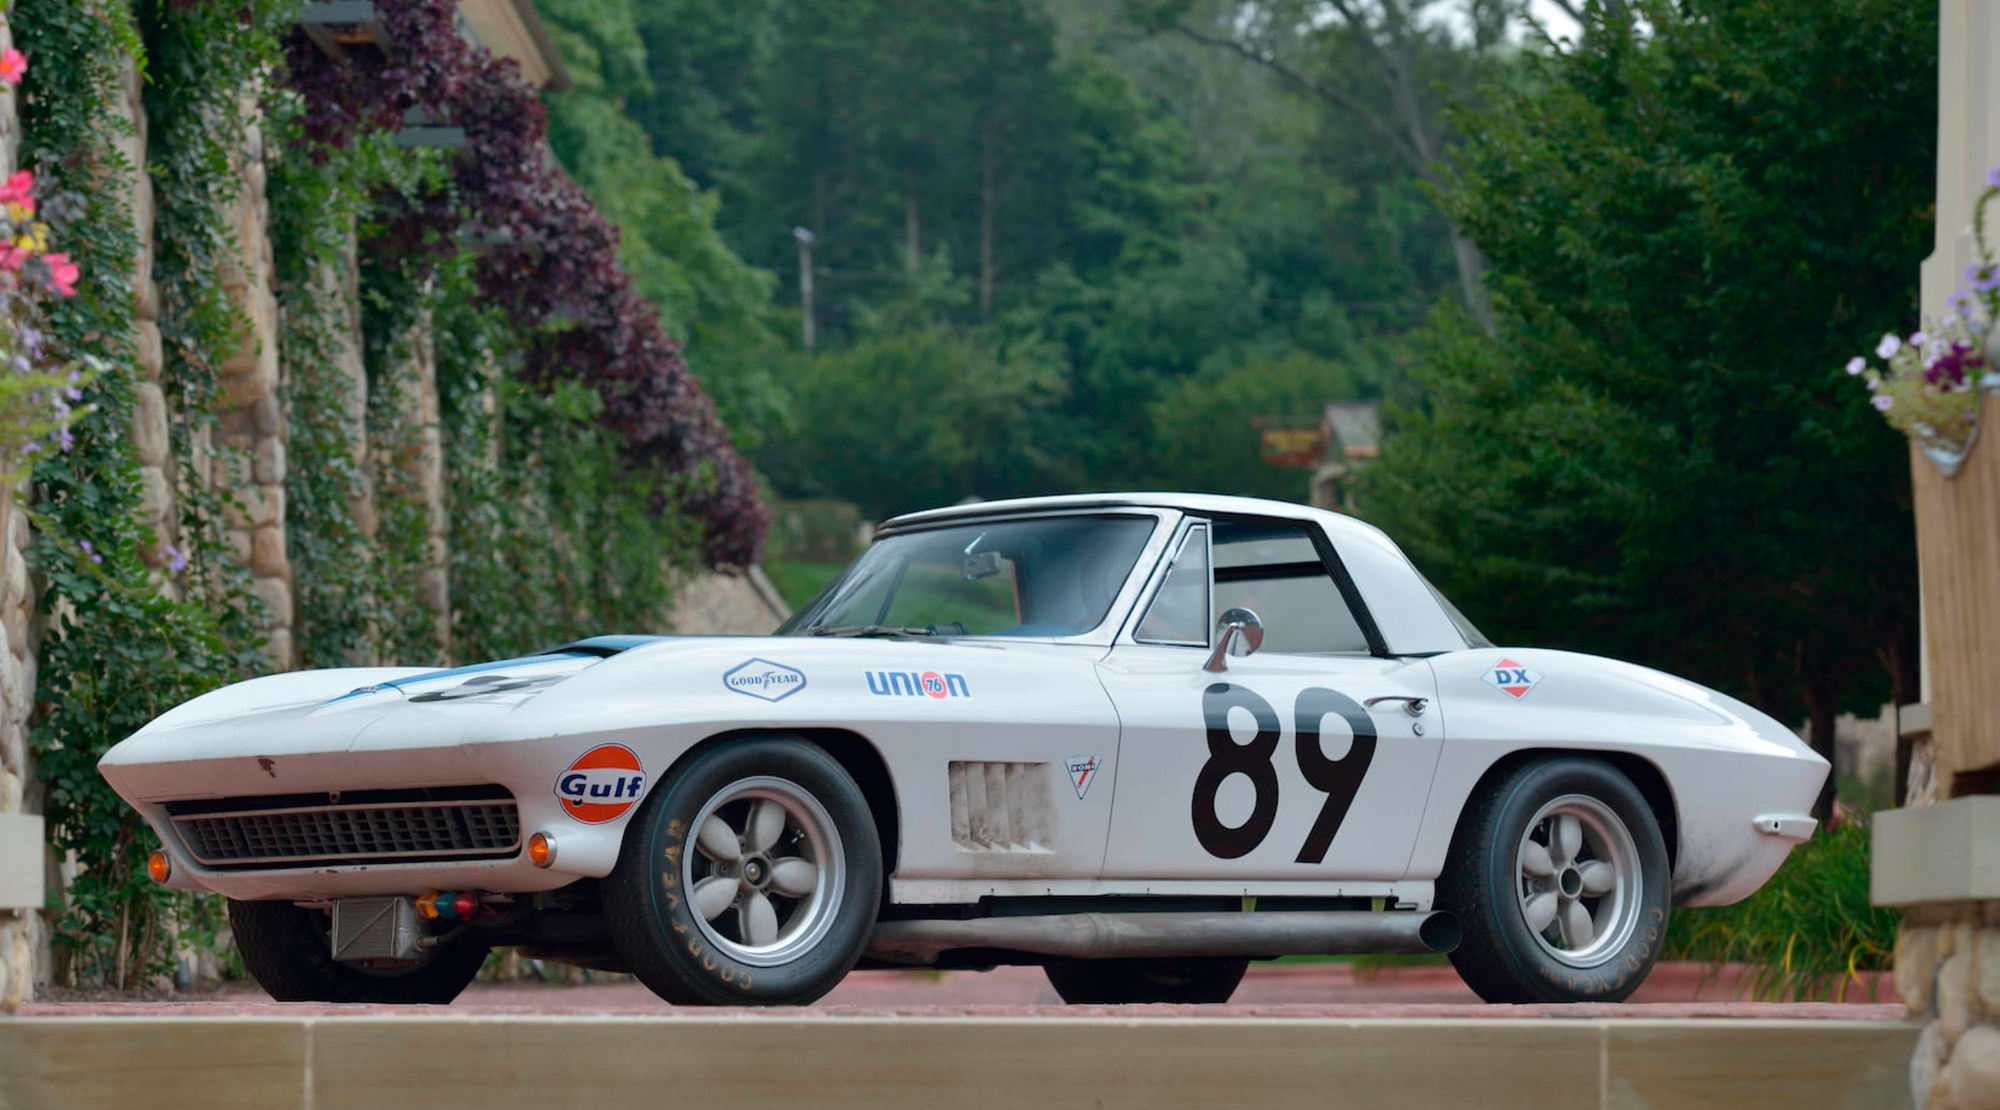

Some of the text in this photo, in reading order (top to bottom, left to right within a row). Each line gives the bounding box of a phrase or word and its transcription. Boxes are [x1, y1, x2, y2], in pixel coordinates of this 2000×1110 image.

[926, 678, 942, 692] 76
[1494, 669, 1531, 684] DX
[1191, 682, 1377, 864] 89
[561, 774, 642, 798] Gulf
